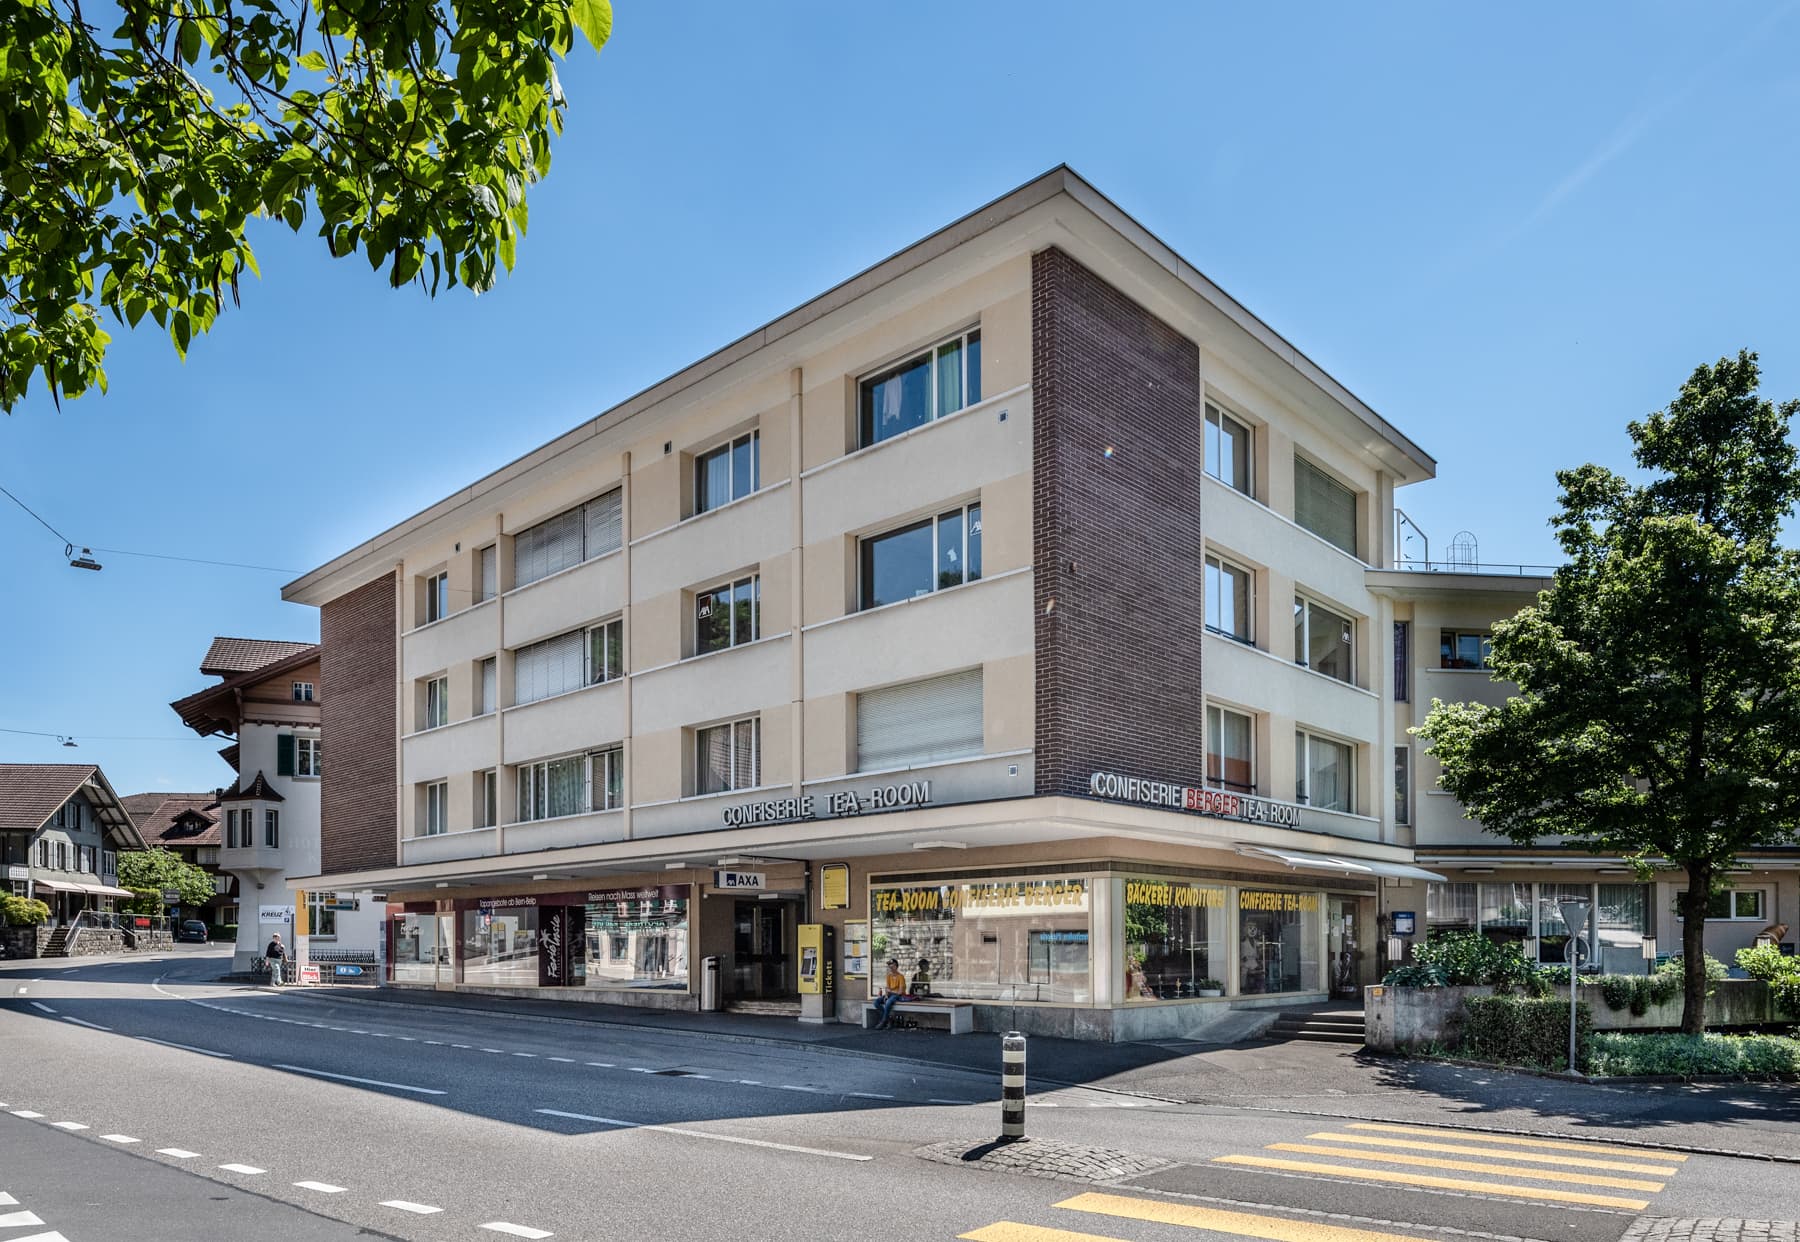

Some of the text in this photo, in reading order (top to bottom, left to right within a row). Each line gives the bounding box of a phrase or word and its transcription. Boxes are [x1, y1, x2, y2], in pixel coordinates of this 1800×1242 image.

[721, 781, 930, 827] CONFISERIE TEA-ROOM
[1092, 772, 1301, 826] CONFISERIE BERGER TEA-ROOM
[738, 874, 759, 886] AXA
[606, 890, 621, 901] nach
[621, 890, 636, 900] Mass
[876, 884, 1084, 912] TEA-ROOM CONFISERIE BERGER
[1126, 882, 1172, 906] BÄCKEREI
[1239, 890, 1319, 913] CONFISERIE TEA-ROOM
[825, 960, 833, 993] Tickets
